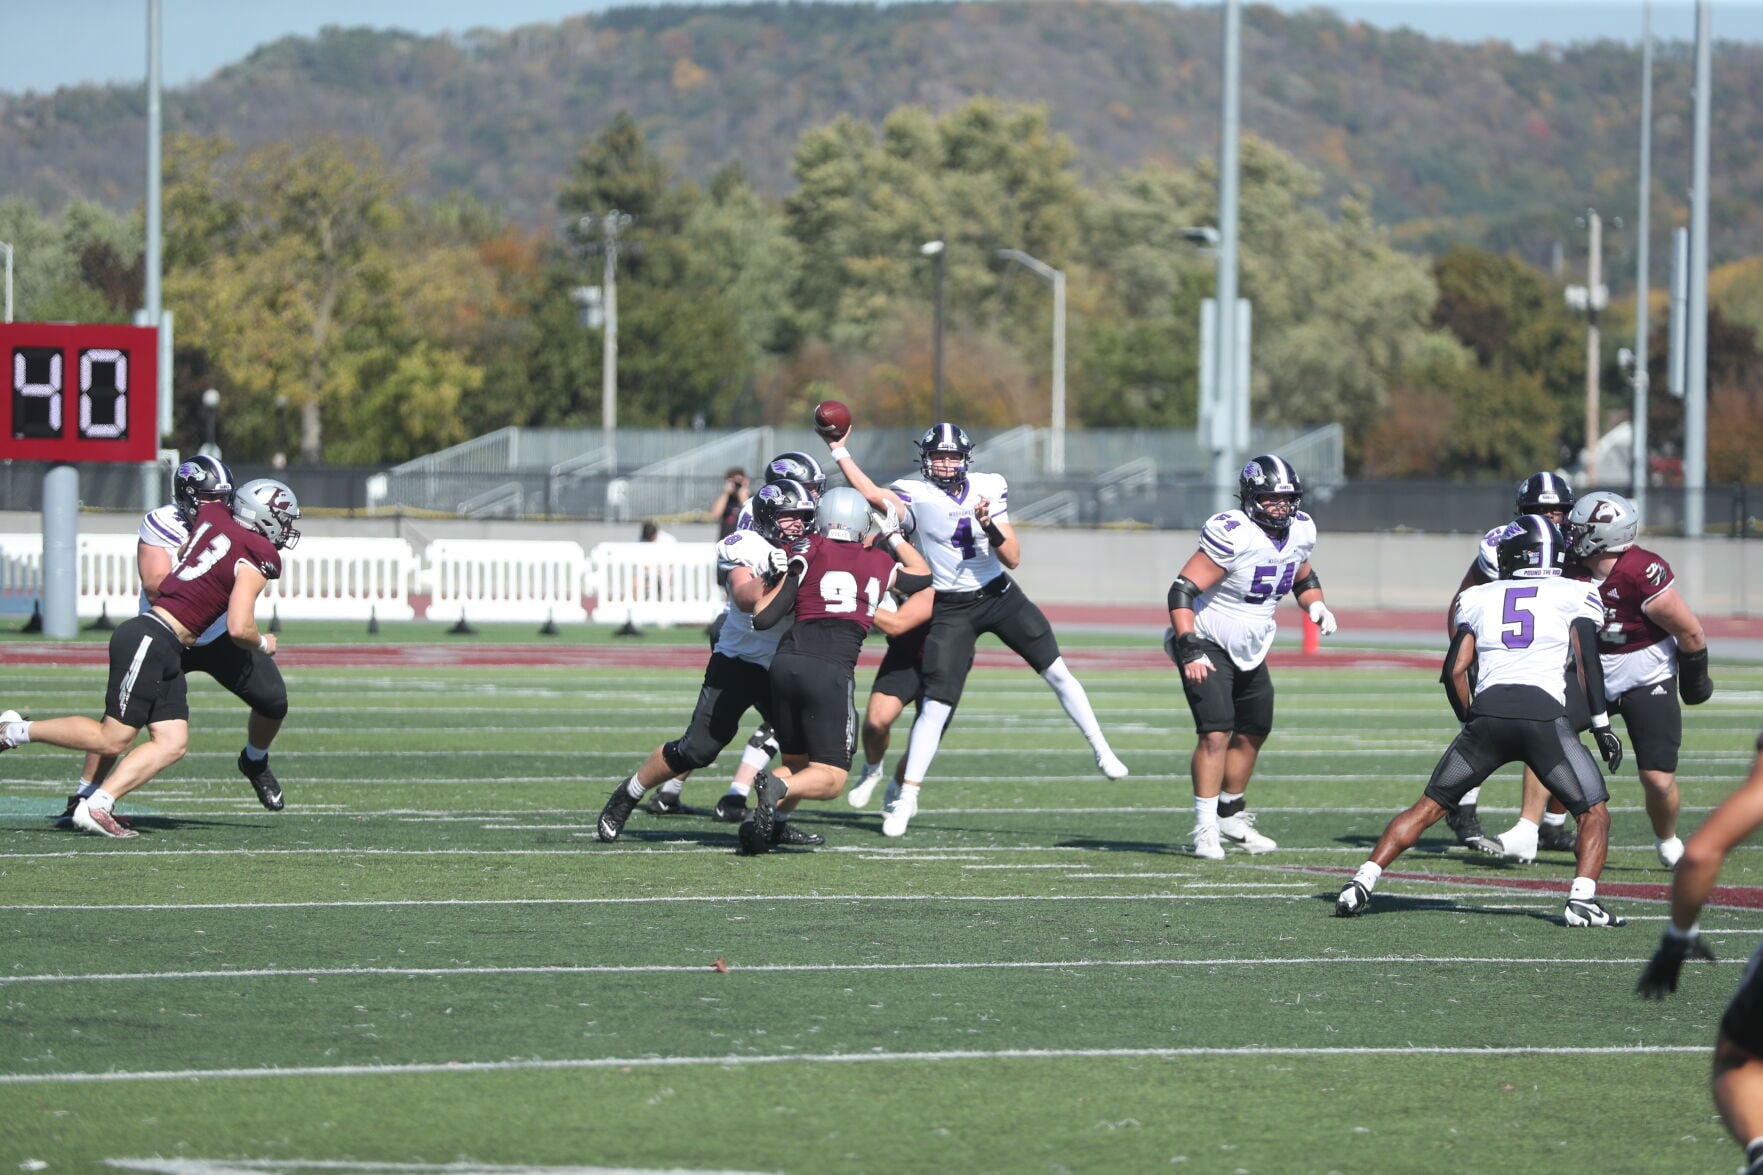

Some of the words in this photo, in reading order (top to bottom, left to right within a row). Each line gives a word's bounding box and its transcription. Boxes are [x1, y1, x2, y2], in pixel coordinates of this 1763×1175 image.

[14, 349, 127, 438] 40
[171, 521, 232, 582] 13
[951, 517, 977, 560] 4
[819, 570, 881, 617] 91
[1244, 561, 1296, 605] 54
[1523, 569, 1541, 577] POUND
[1501, 586, 1538, 649] 5
